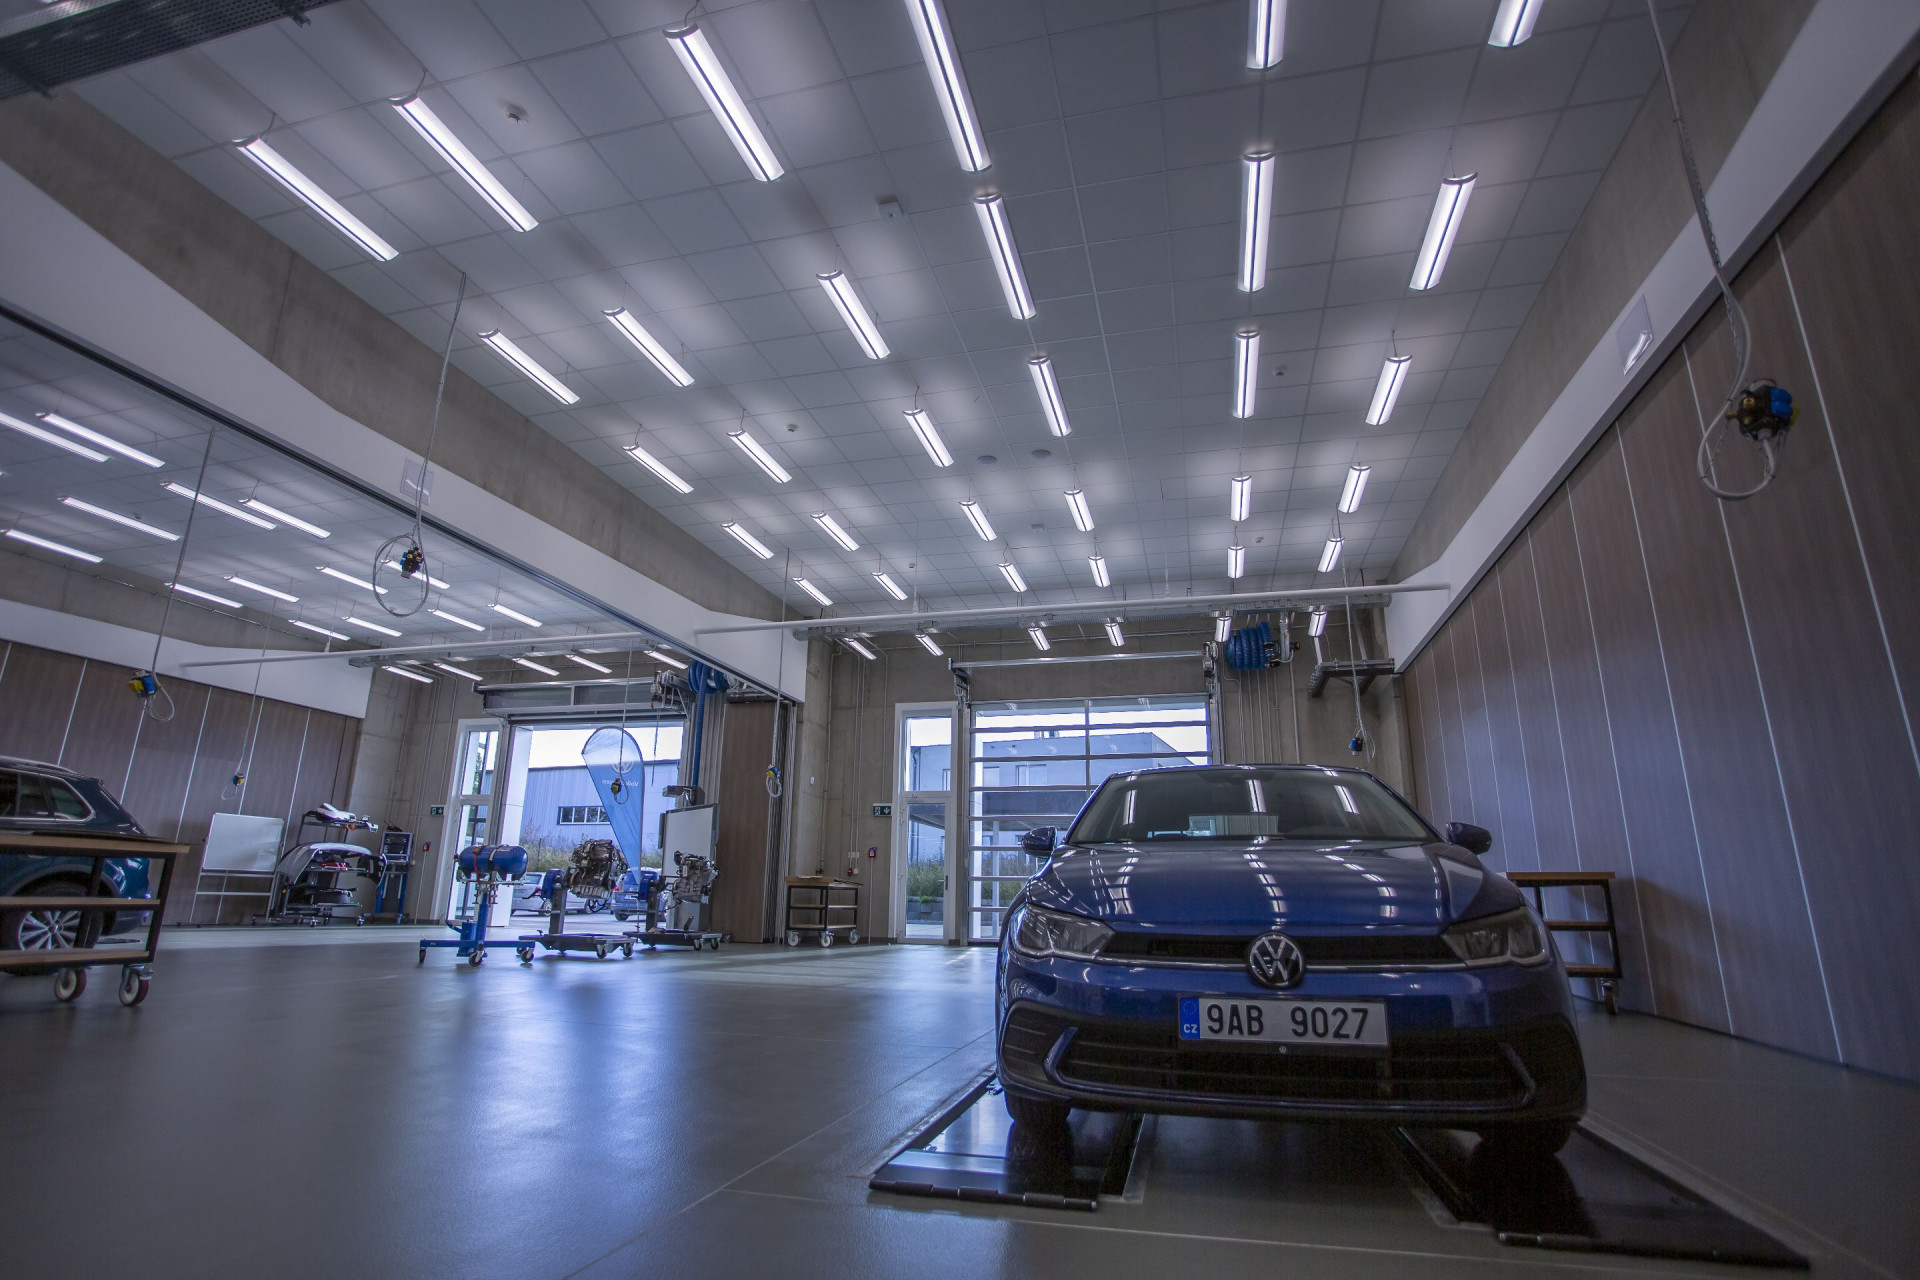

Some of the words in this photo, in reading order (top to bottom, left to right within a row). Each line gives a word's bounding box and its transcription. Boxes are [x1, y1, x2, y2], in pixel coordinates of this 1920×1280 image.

[1250, 935, 1302, 985] VW
[1183, 1023, 1198, 1034] CZ
[1206, 1003, 1264, 1036] 9AB
[1290, 1005, 1369, 1039] 9027
